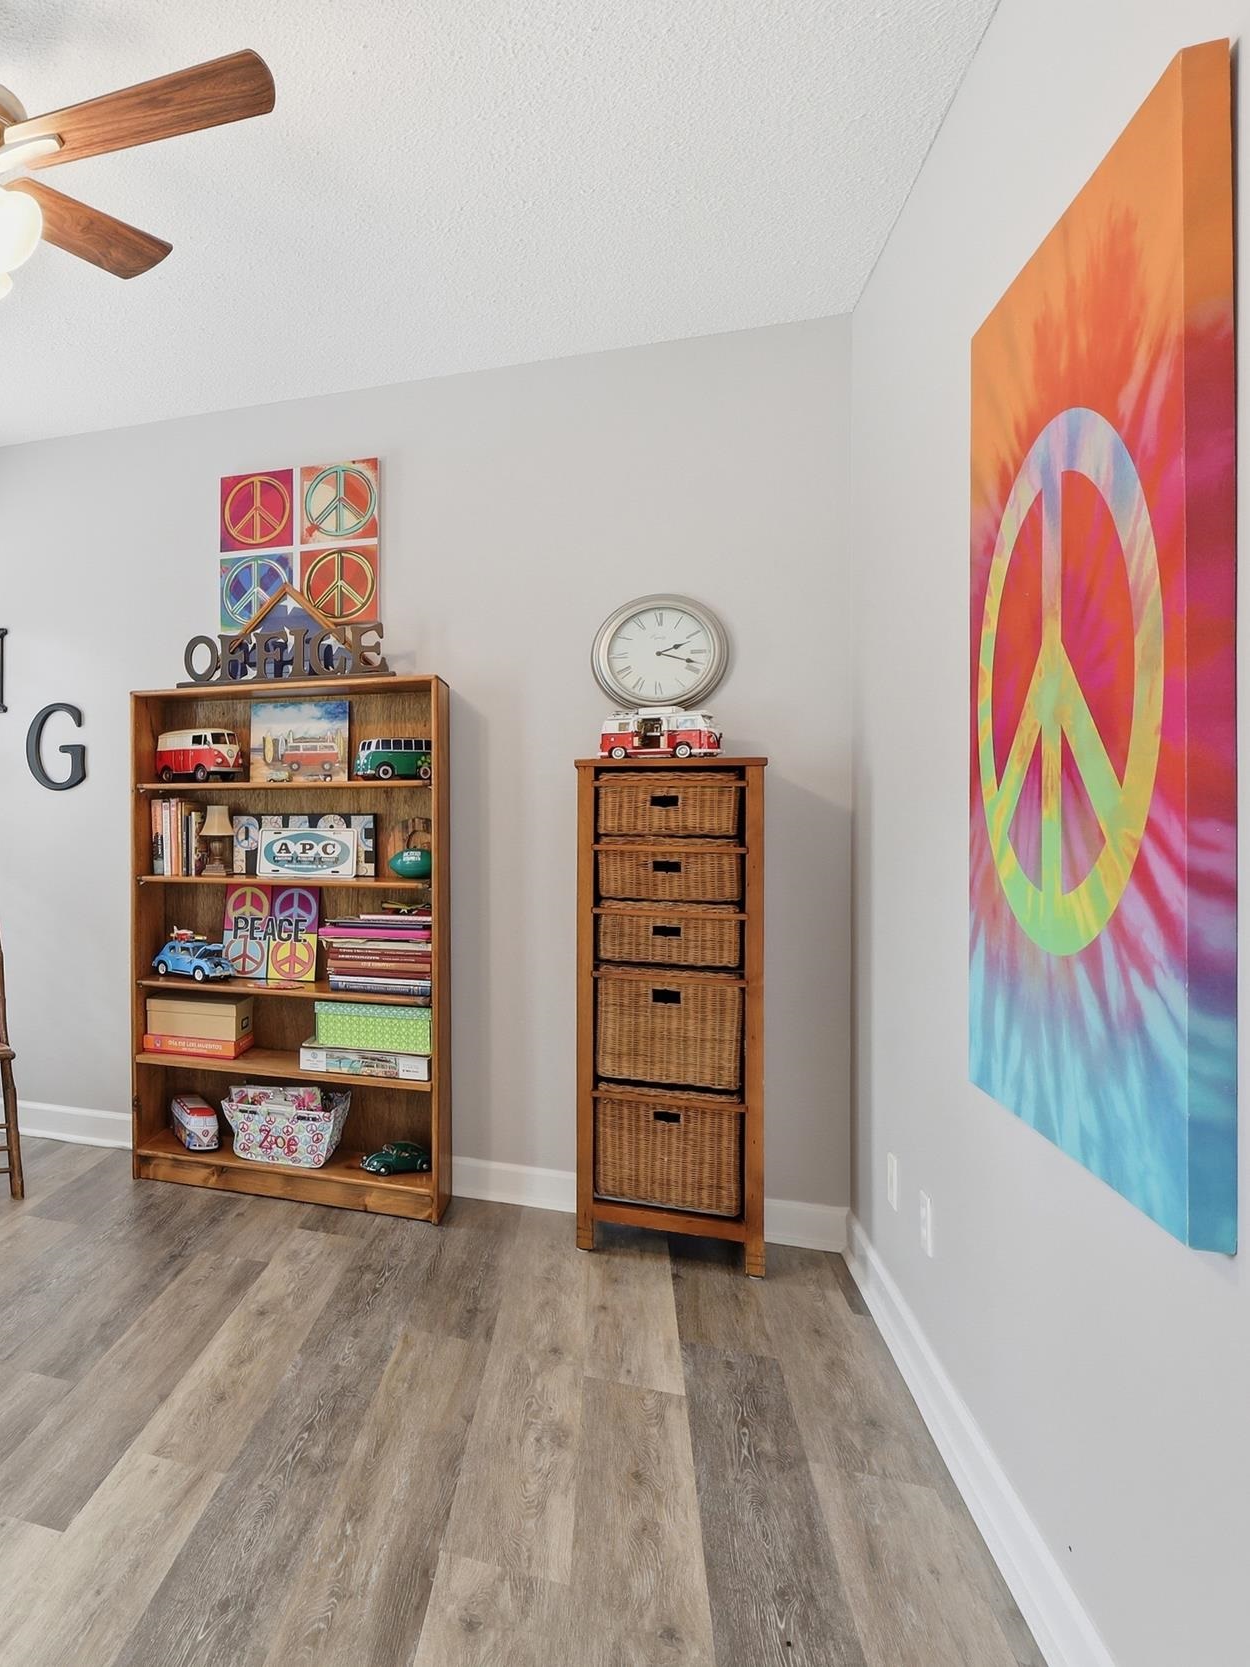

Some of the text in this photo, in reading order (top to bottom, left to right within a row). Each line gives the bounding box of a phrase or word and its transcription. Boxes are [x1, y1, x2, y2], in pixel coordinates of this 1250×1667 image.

[184, 622, 391, 682] OFFICE
[25, 702, 87, 791] G
[233, 915, 308, 943] PEACE
